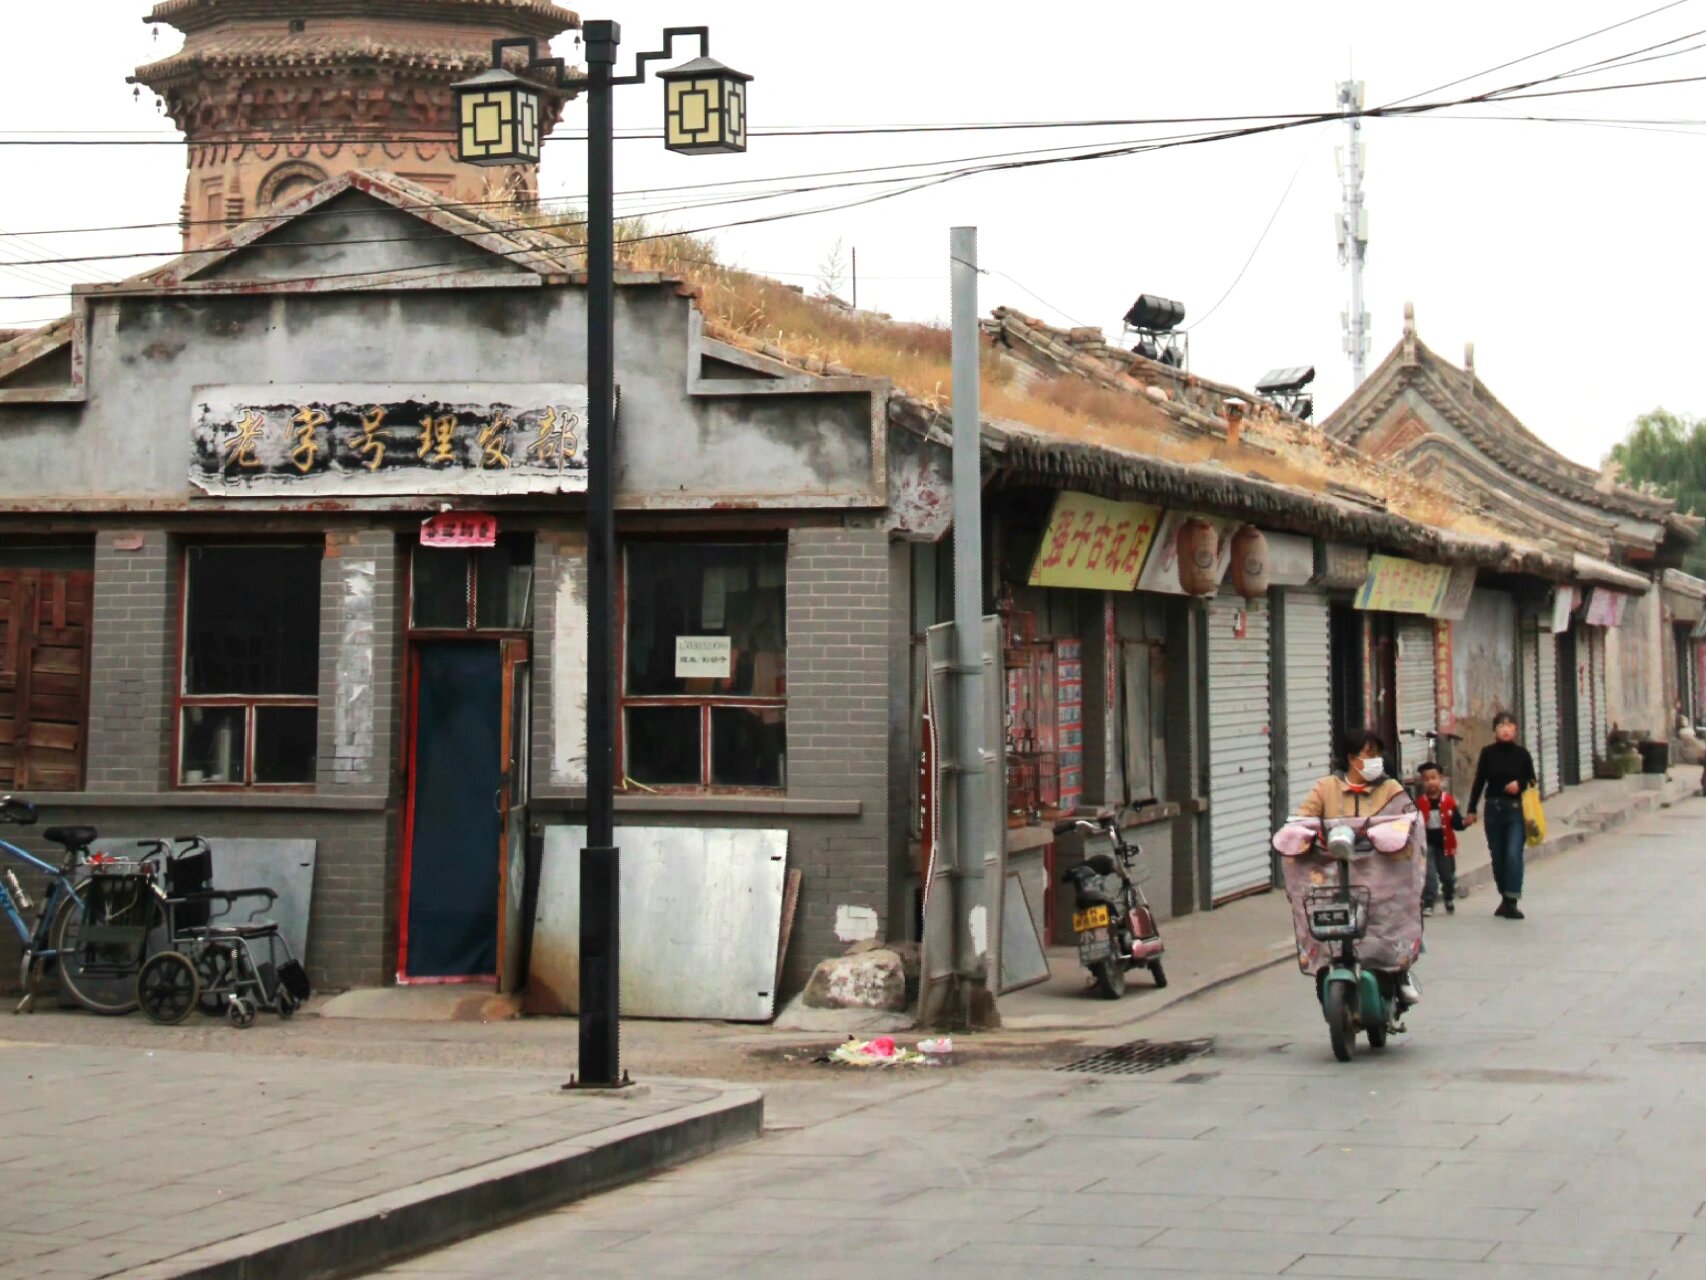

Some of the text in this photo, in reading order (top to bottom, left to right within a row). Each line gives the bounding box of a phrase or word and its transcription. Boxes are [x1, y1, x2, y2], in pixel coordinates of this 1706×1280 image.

[222, 405, 579, 472] 老字号理发部
[1042, 510, 1150, 574] 强子古玩店
